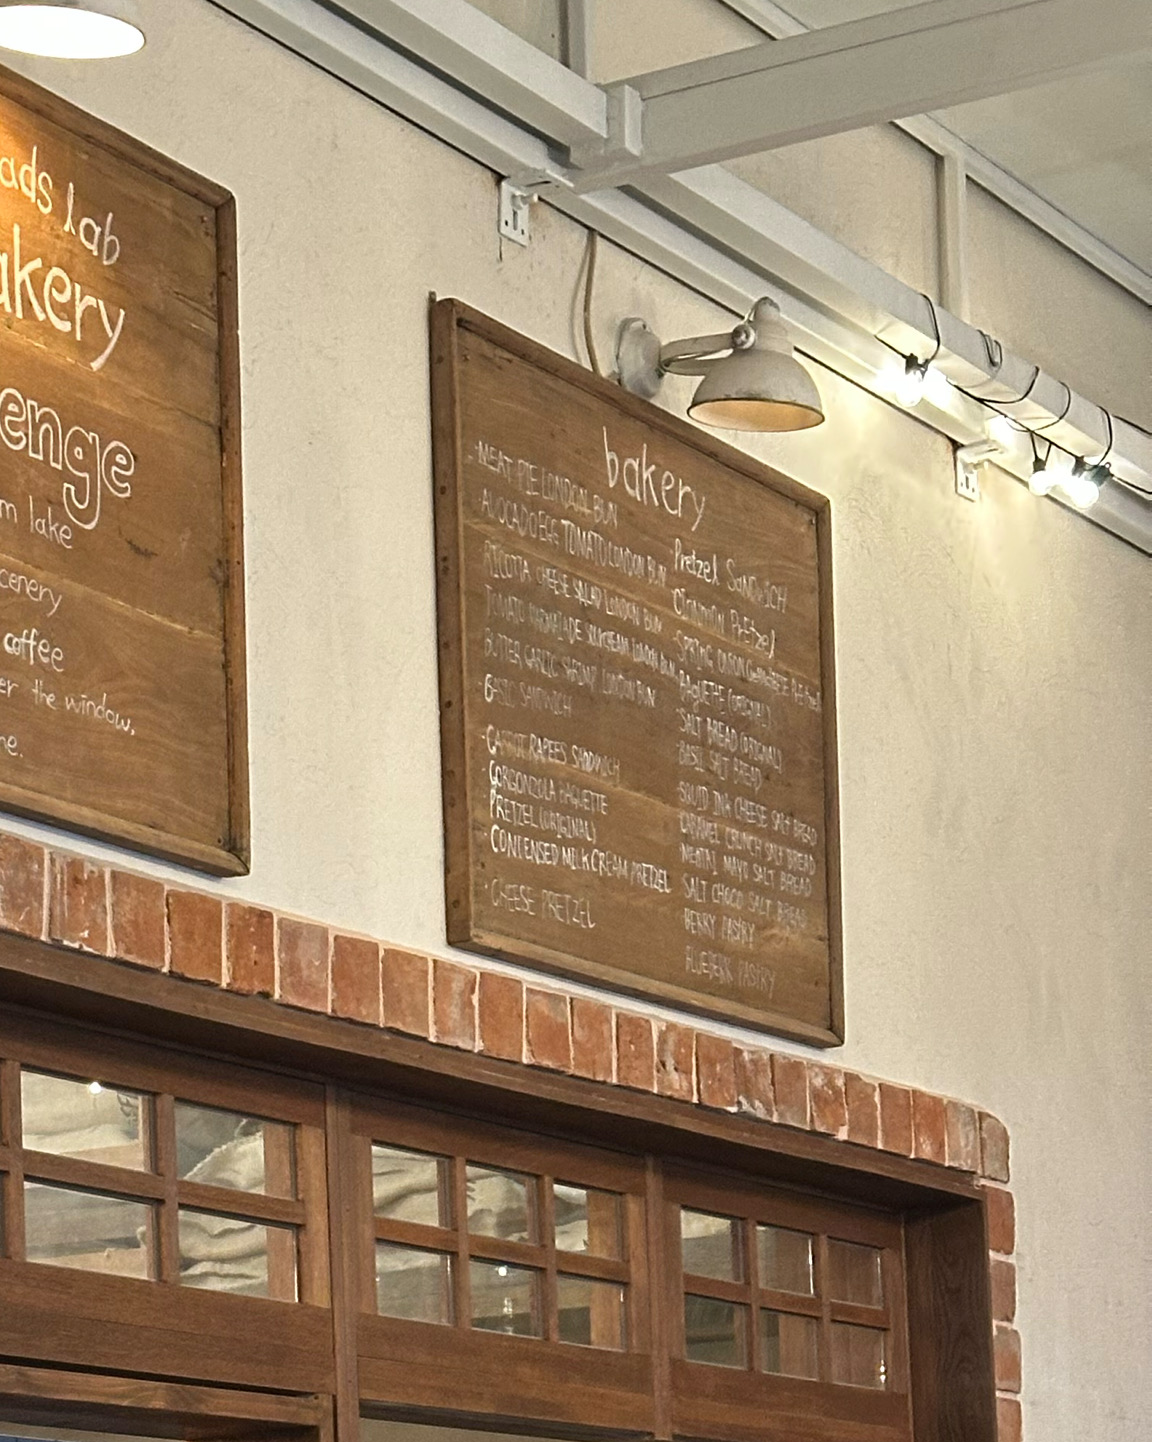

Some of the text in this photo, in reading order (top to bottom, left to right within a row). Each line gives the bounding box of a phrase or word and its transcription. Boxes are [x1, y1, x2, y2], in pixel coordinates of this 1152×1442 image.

[62, 182, 121, 266] lab
[517, 459, 540, 496] PIE
[602, 425, 706, 532] bakery
[28, 495, 74, 550] lake
[561, 518, 607, 567] TOMATO
[4, 627, 65, 672] coffee
[31, 679, 57, 709] the
[489, 760, 556, 801] GORGONZOLA
[490, 788, 538, 828] PRETZEL
[591, 849, 628, 878] CREAM
[491, 879, 596, 928] CHEESE PRETZEL
